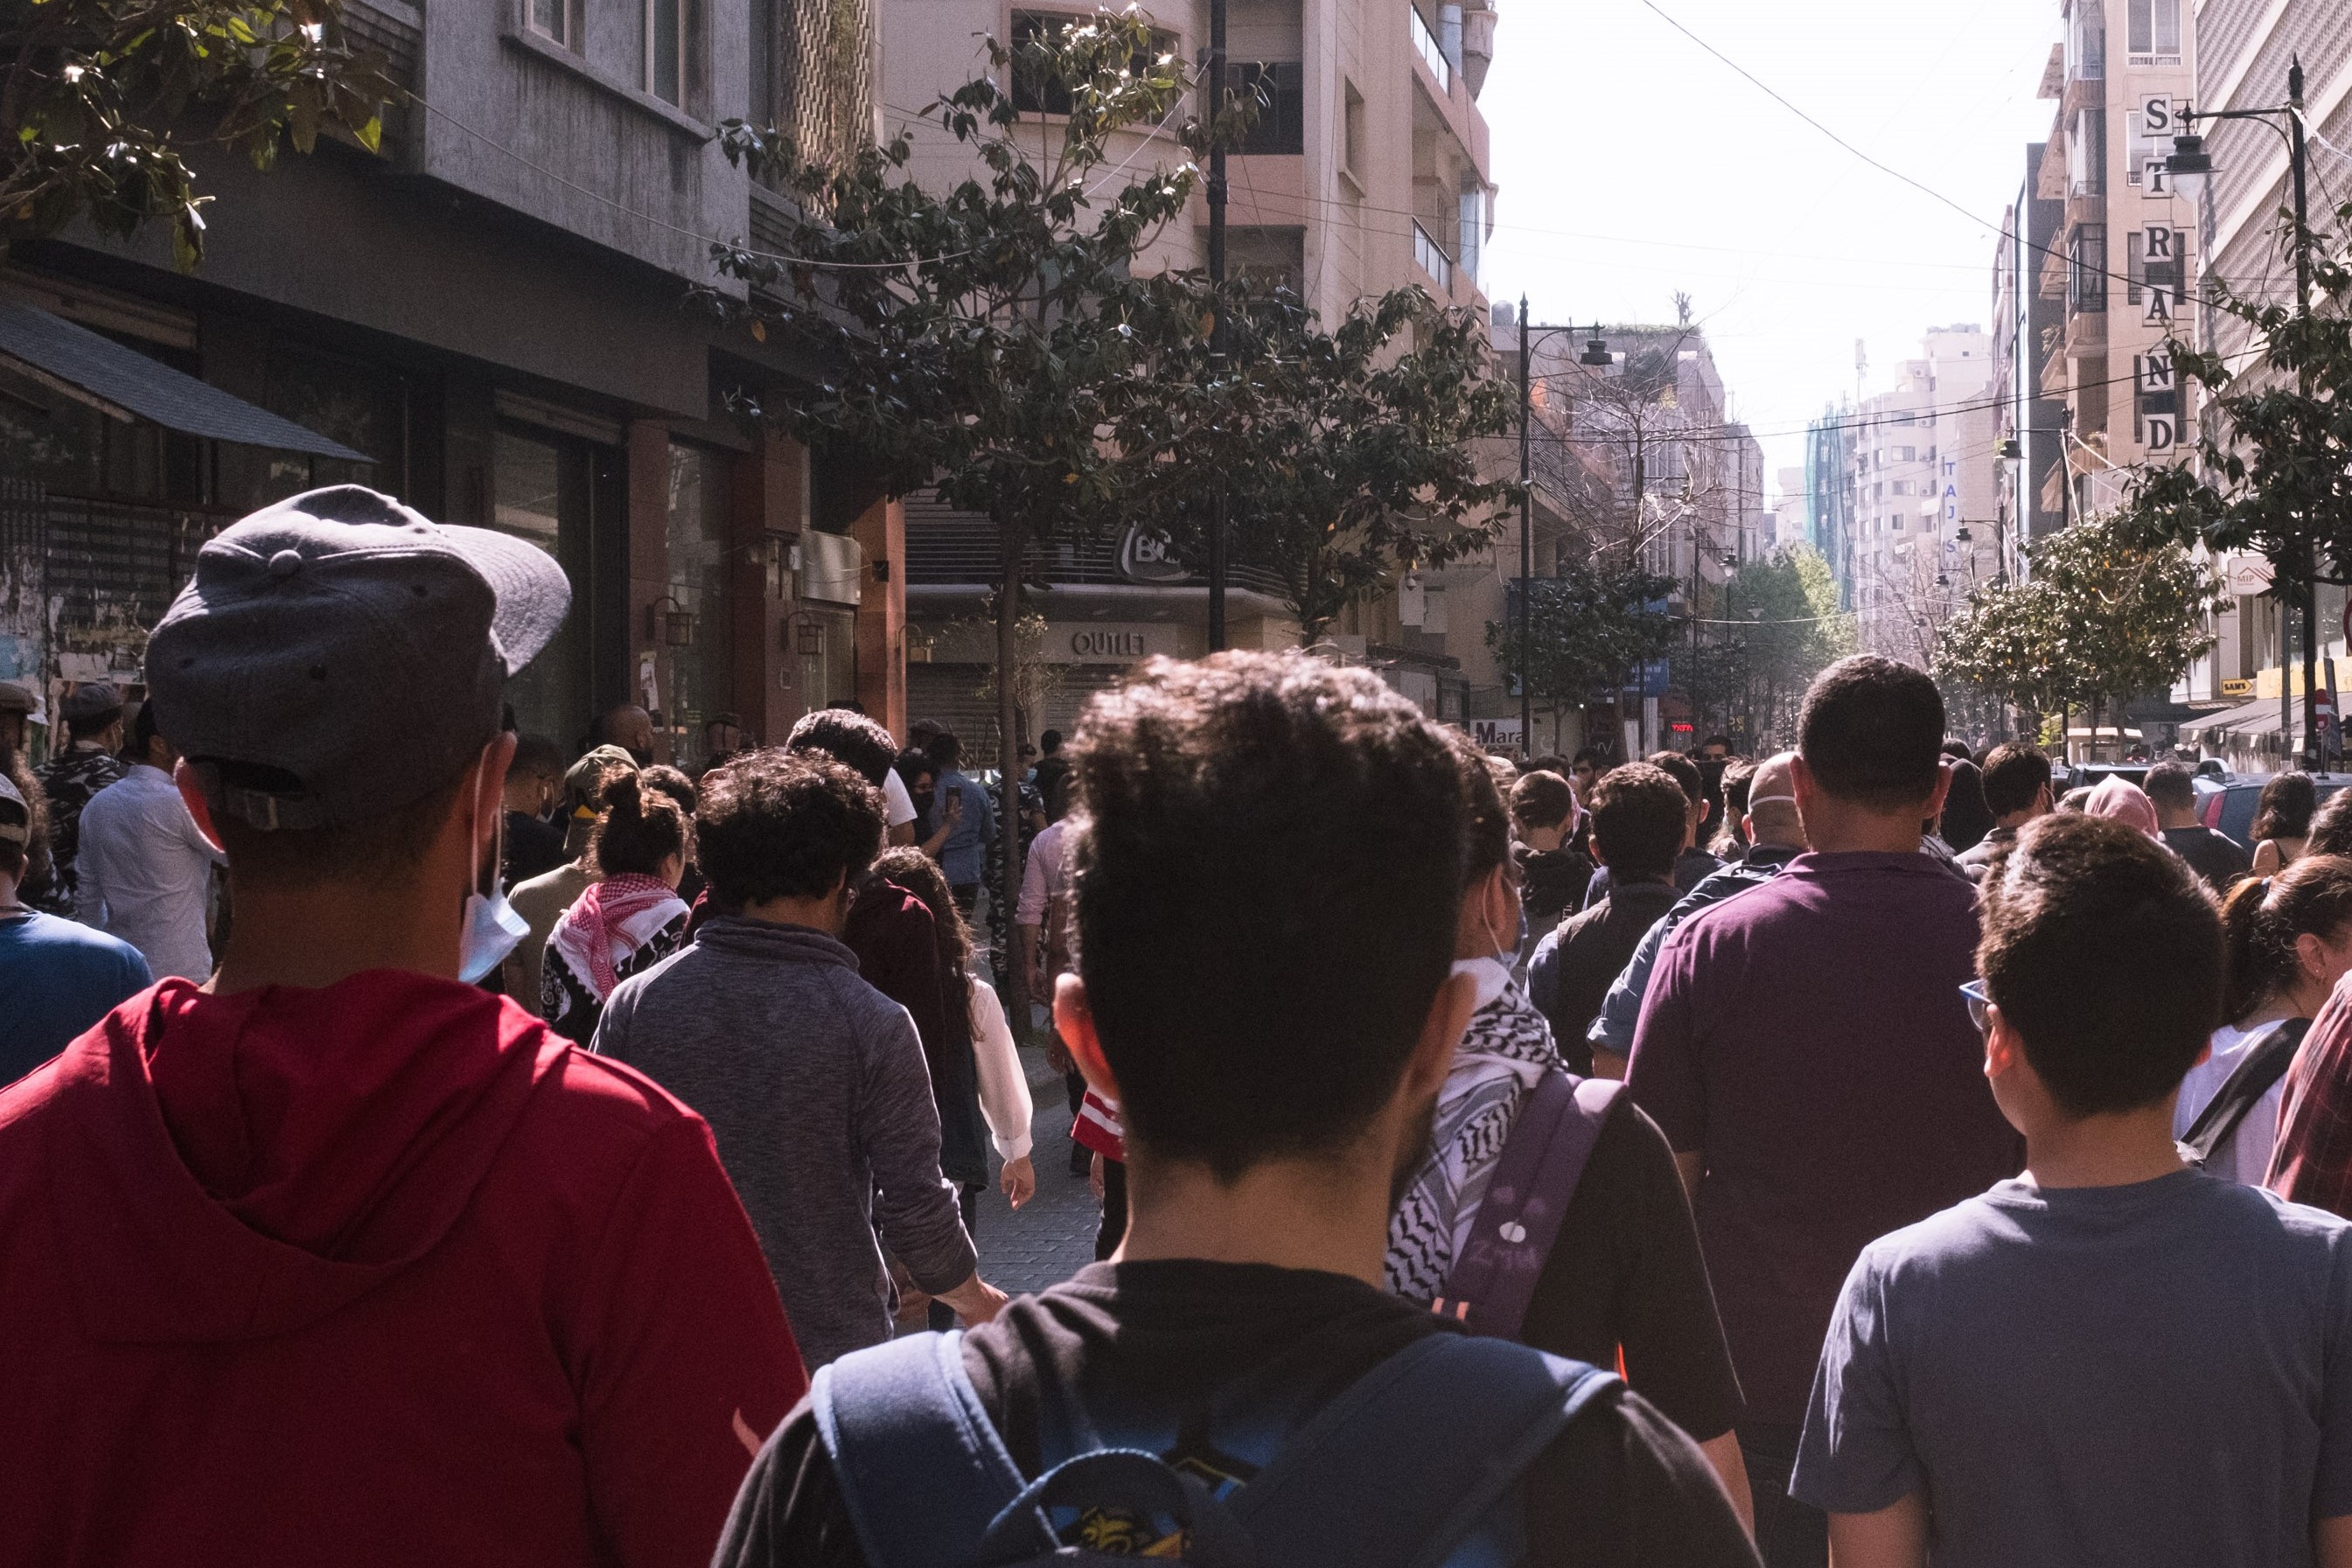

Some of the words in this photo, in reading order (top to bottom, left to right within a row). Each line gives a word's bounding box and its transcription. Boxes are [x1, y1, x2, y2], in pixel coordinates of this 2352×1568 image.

[2146, 98, 2174, 450] STRAND
[1945, 462, 1957, 519] TAJ
[1072, 631, 1145, 656] OUTLET
